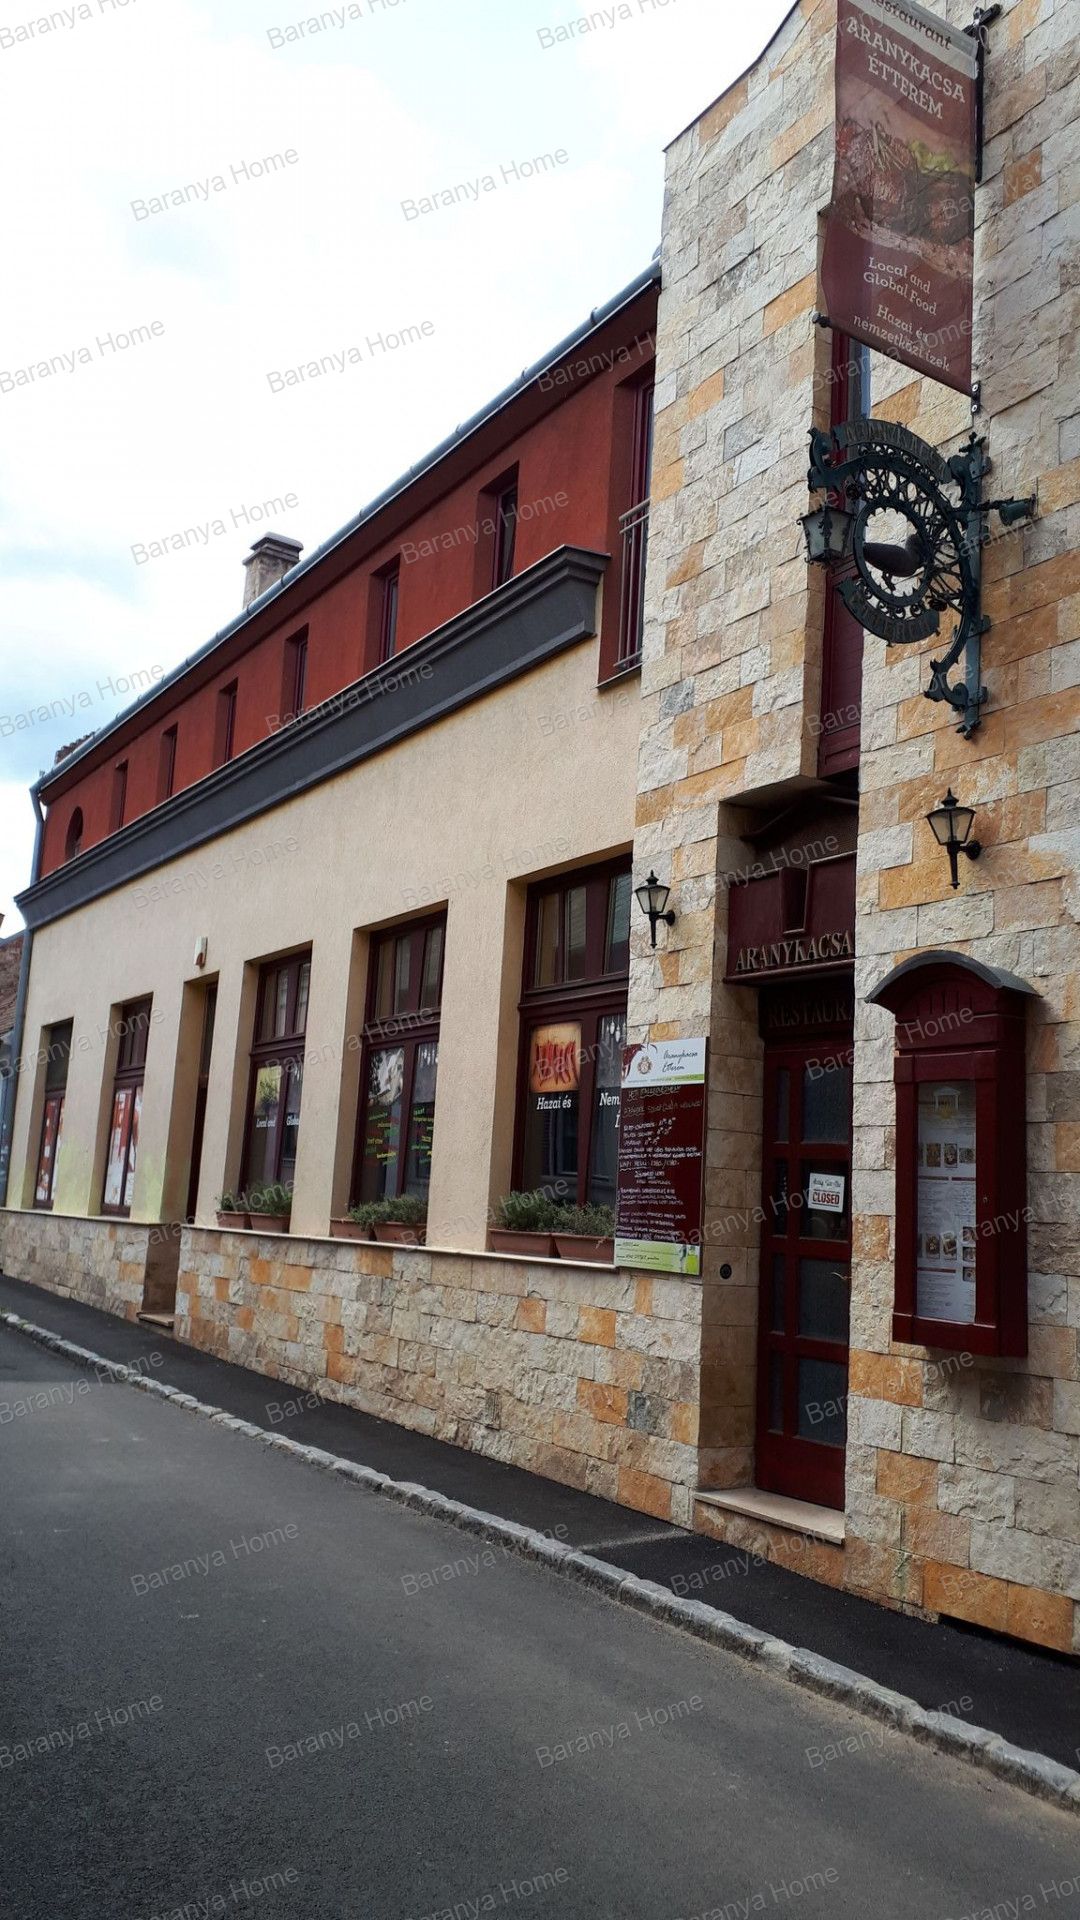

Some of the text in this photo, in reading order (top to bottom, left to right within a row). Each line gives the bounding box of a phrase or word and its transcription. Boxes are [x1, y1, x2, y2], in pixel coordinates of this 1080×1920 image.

[872, 0, 952, 50] estaurant
[847, 16, 966, 103] ARANYKACSA
[868, 52, 943, 119] ÉTTEREM
[863, 272, 937, 315] Global Food
[868, 257, 931, 294] Local and
[876, 304, 913, 335] Hazai
[735, 929, 853, 972] ARANYKACSA
[767, 998, 853, 1028] RESTAUR
[536, 1094, 572, 1110] Hazai és
[812, 1191, 841, 1205] CLOSED
